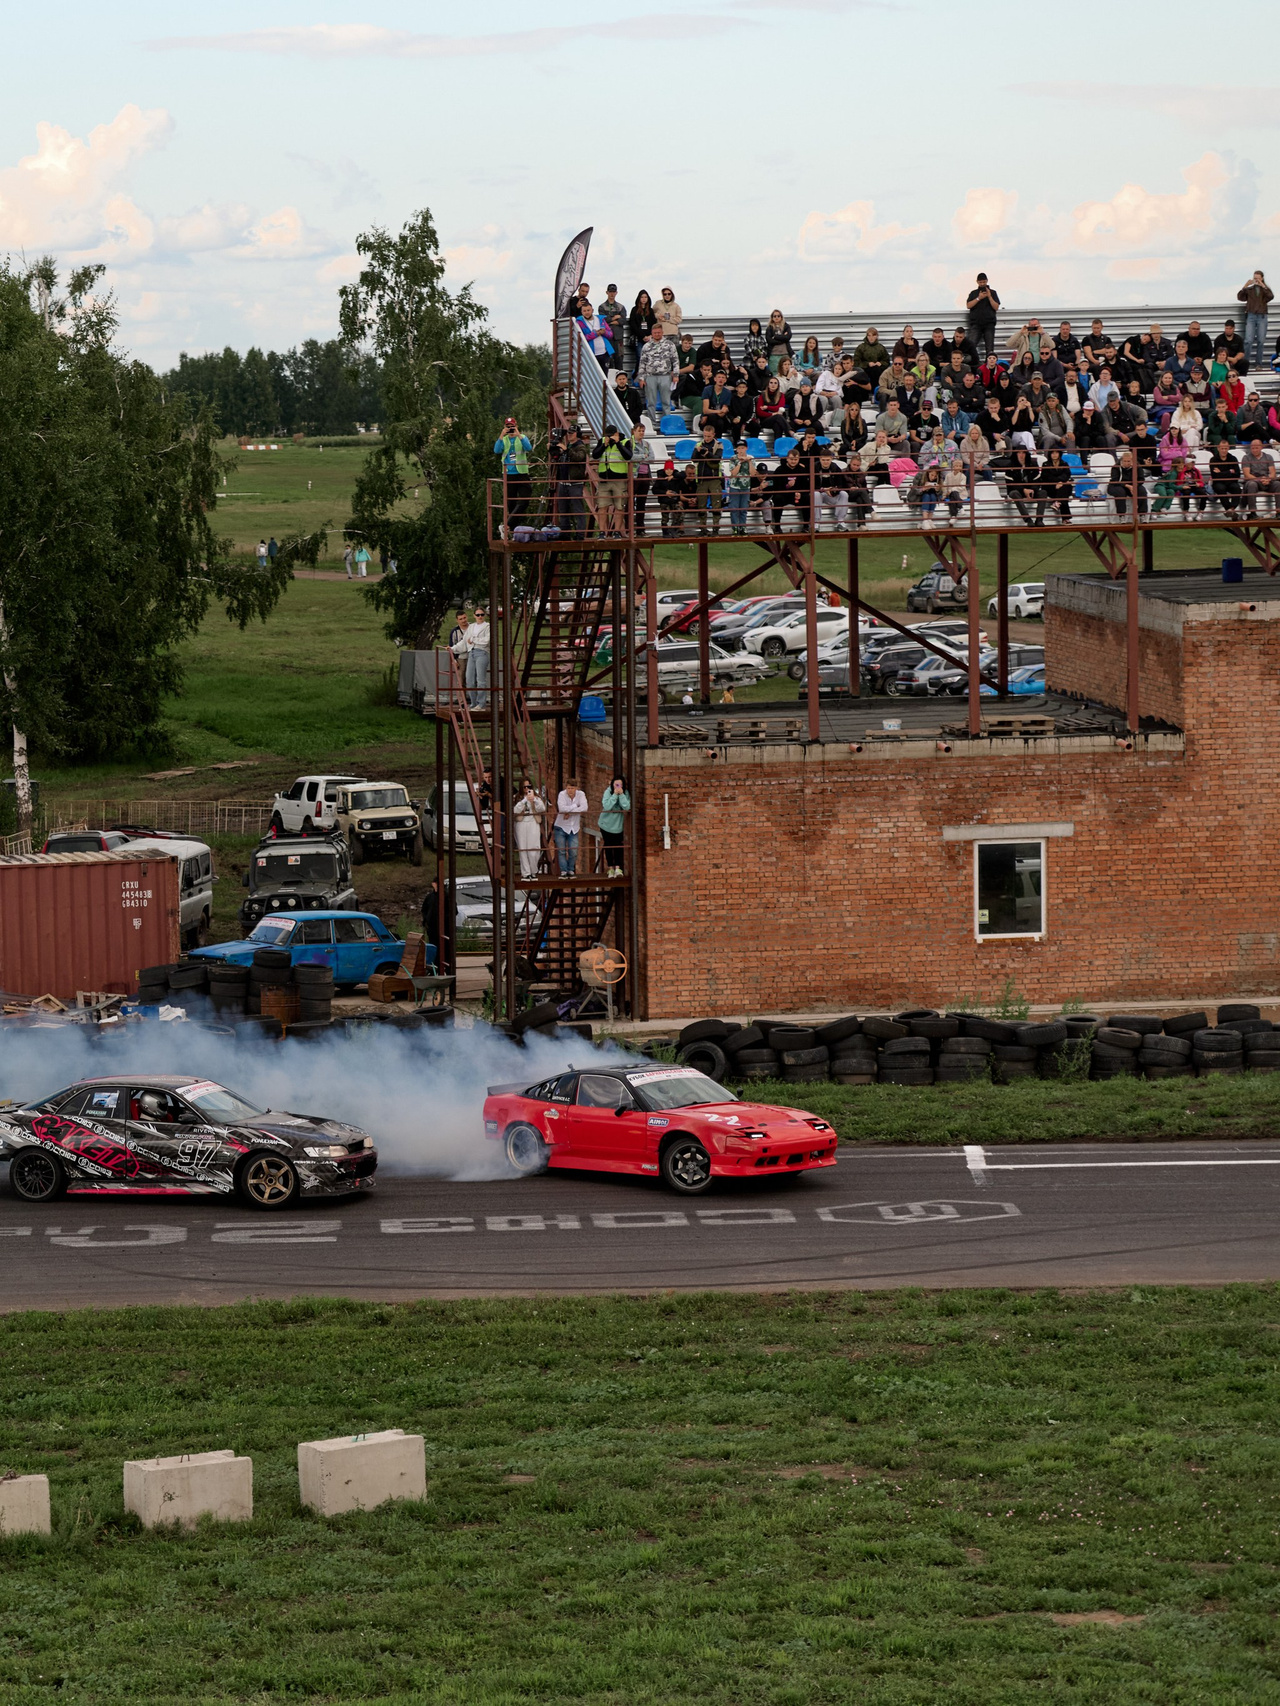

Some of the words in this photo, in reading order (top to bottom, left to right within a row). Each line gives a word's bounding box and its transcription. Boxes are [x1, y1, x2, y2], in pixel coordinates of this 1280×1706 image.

[121, 881, 139, 889] CRXU
[104, 1131, 126, 1145] СОЮЗ
[52, 1146, 77, 1161] СОЮЗ
[176, 1139, 222, 1168] 97
[89, 1162, 113, 1176] СОЮЗ
[380, 1207, 797, 1234] СОЮЗ
